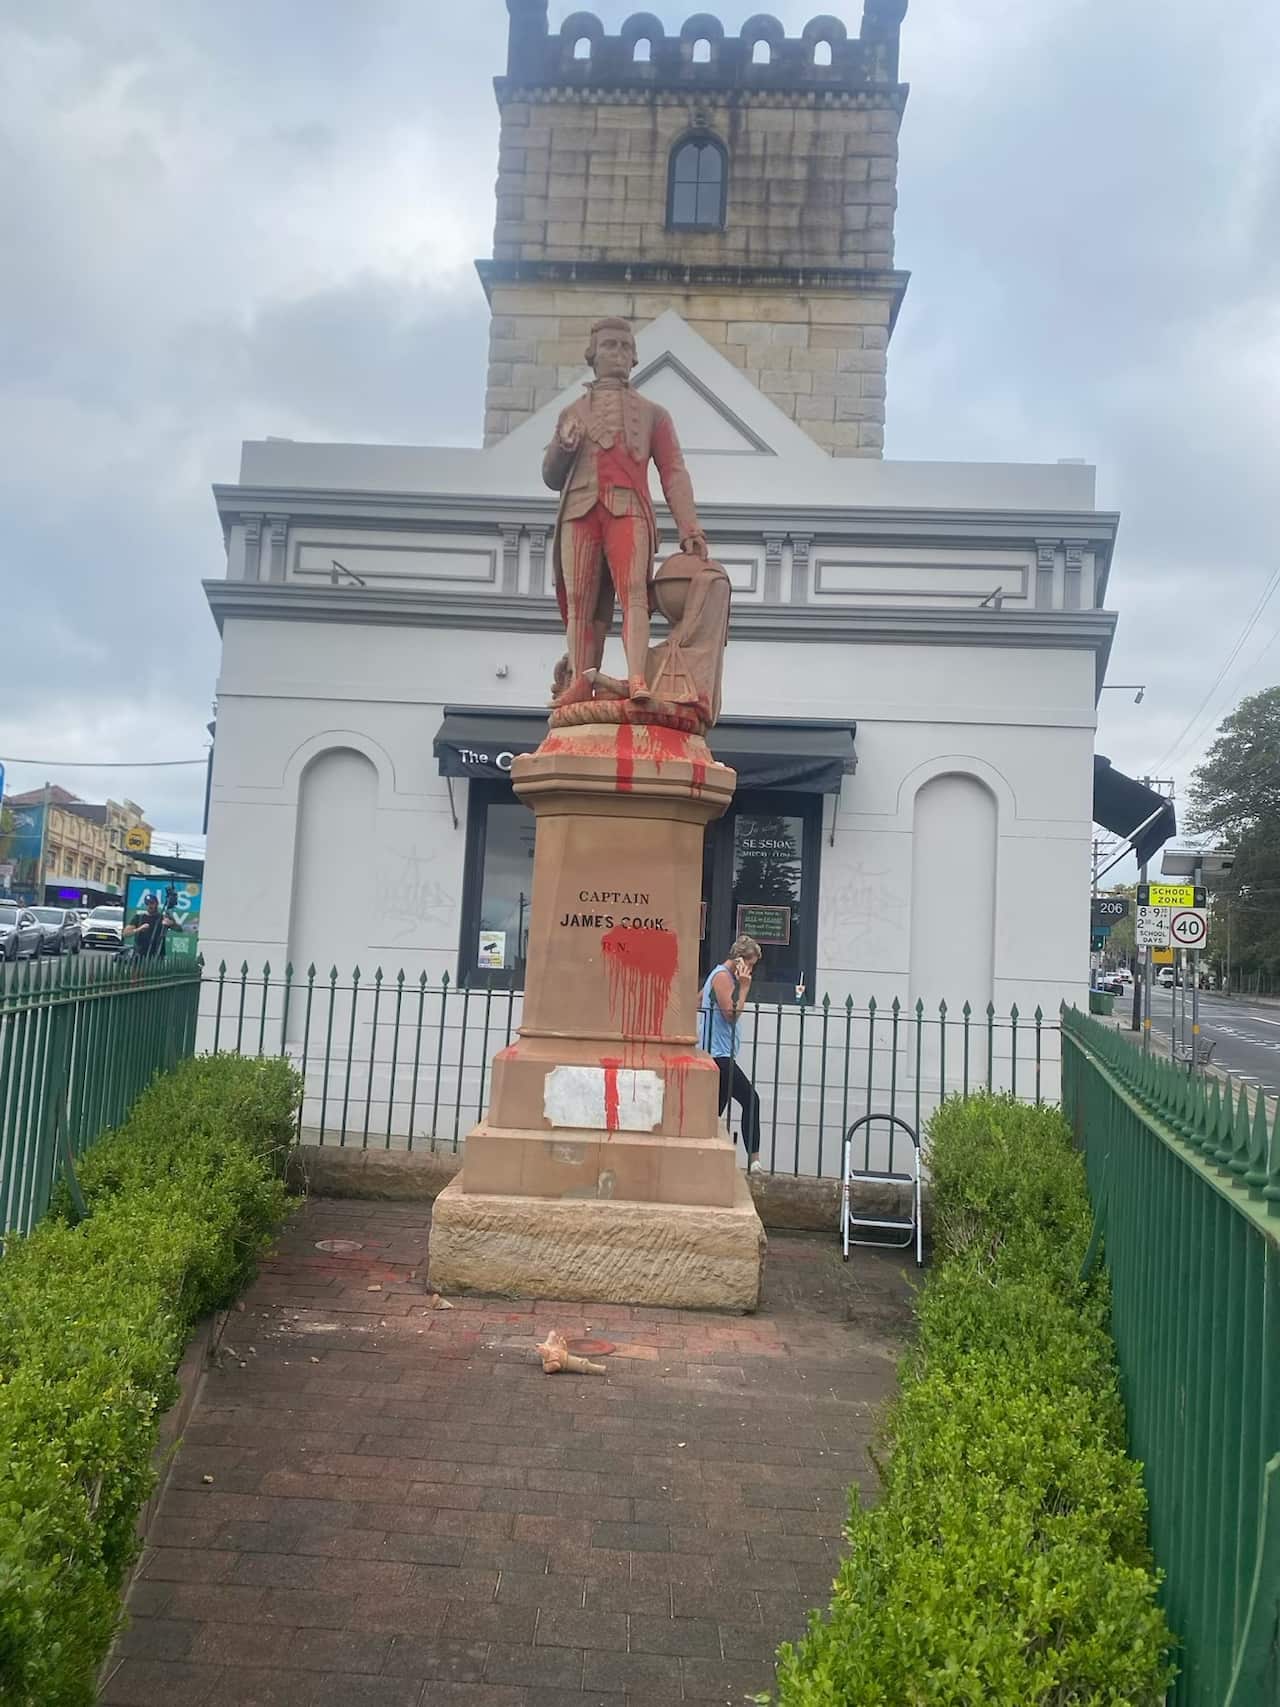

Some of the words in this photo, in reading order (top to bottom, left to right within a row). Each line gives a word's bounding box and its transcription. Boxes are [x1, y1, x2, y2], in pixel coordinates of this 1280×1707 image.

[458, 749, 489, 764] The
[579, 890, 650, 905] CAPTAIN
[1152, 888, 1190, 897] SCHOOL
[1100, 903, 1123, 914] 206
[560, 914, 614, 929] JAMES
[1176, 920, 1200, 935] 40
